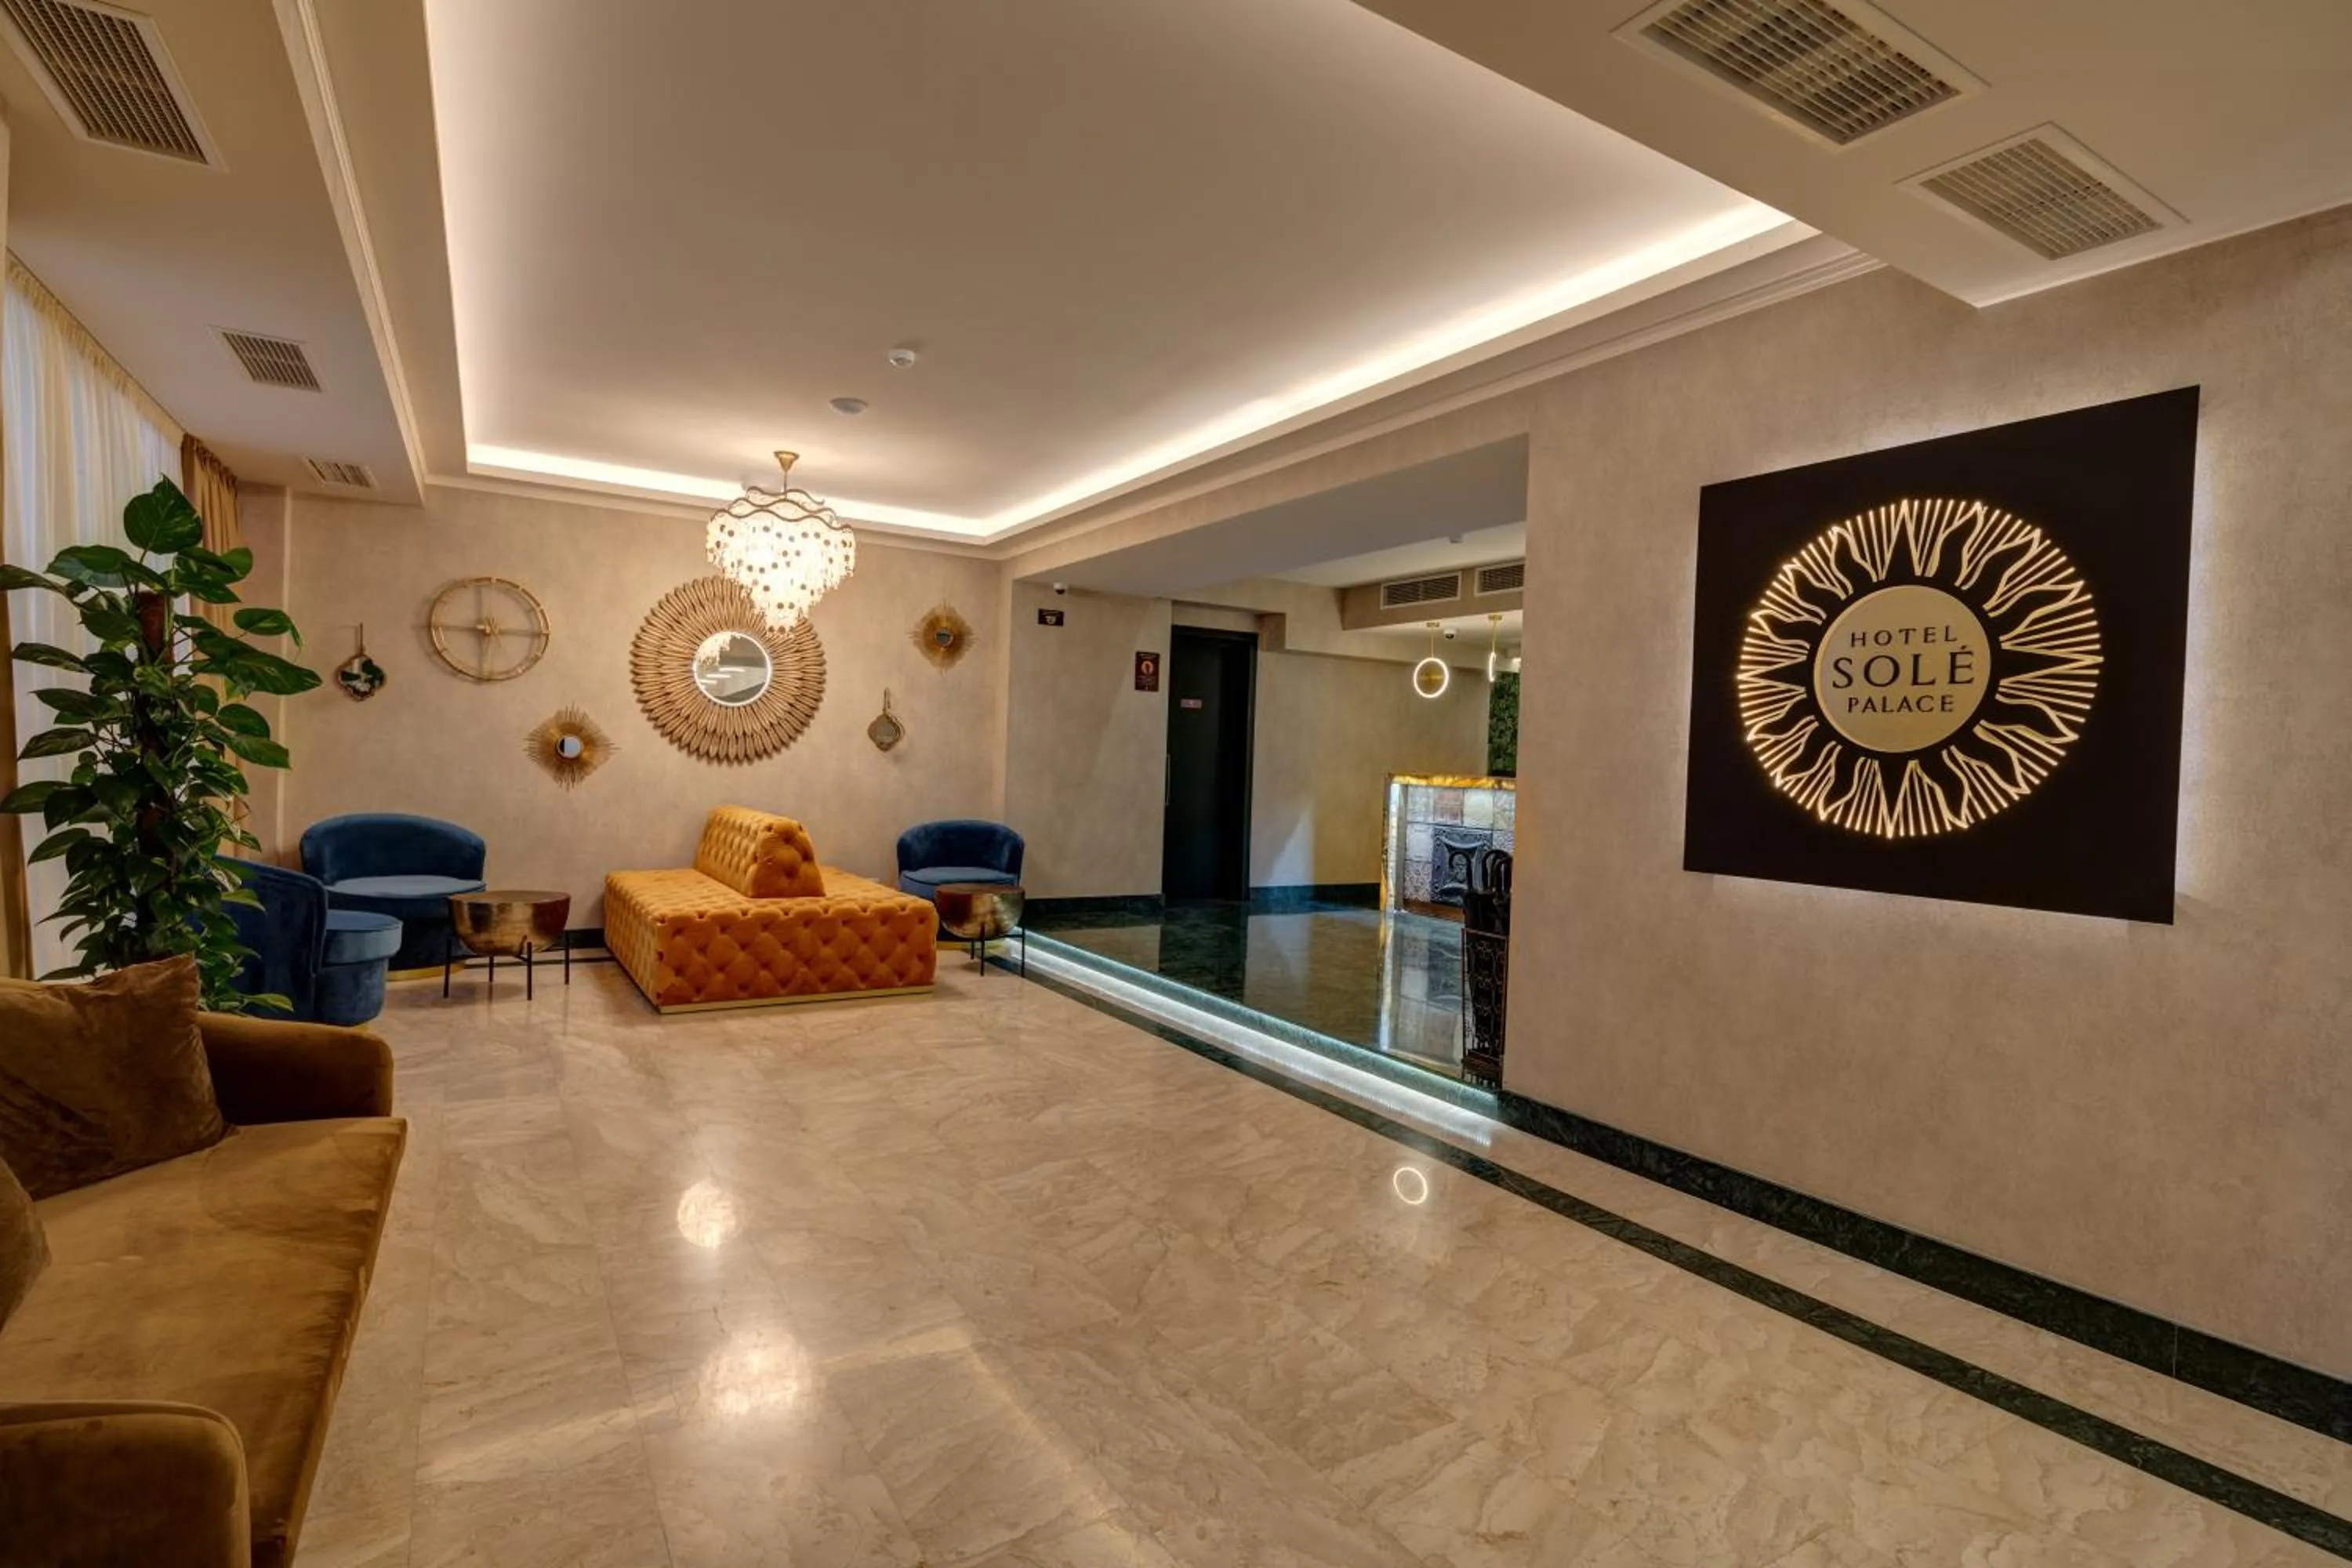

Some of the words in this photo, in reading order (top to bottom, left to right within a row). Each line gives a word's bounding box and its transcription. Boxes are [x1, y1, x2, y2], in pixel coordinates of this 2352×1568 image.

[1850, 625, 1958, 648] HOTEL
[1831, 645, 1975, 689] SOLÉ
[1847, 695, 1955, 713] PALACE
